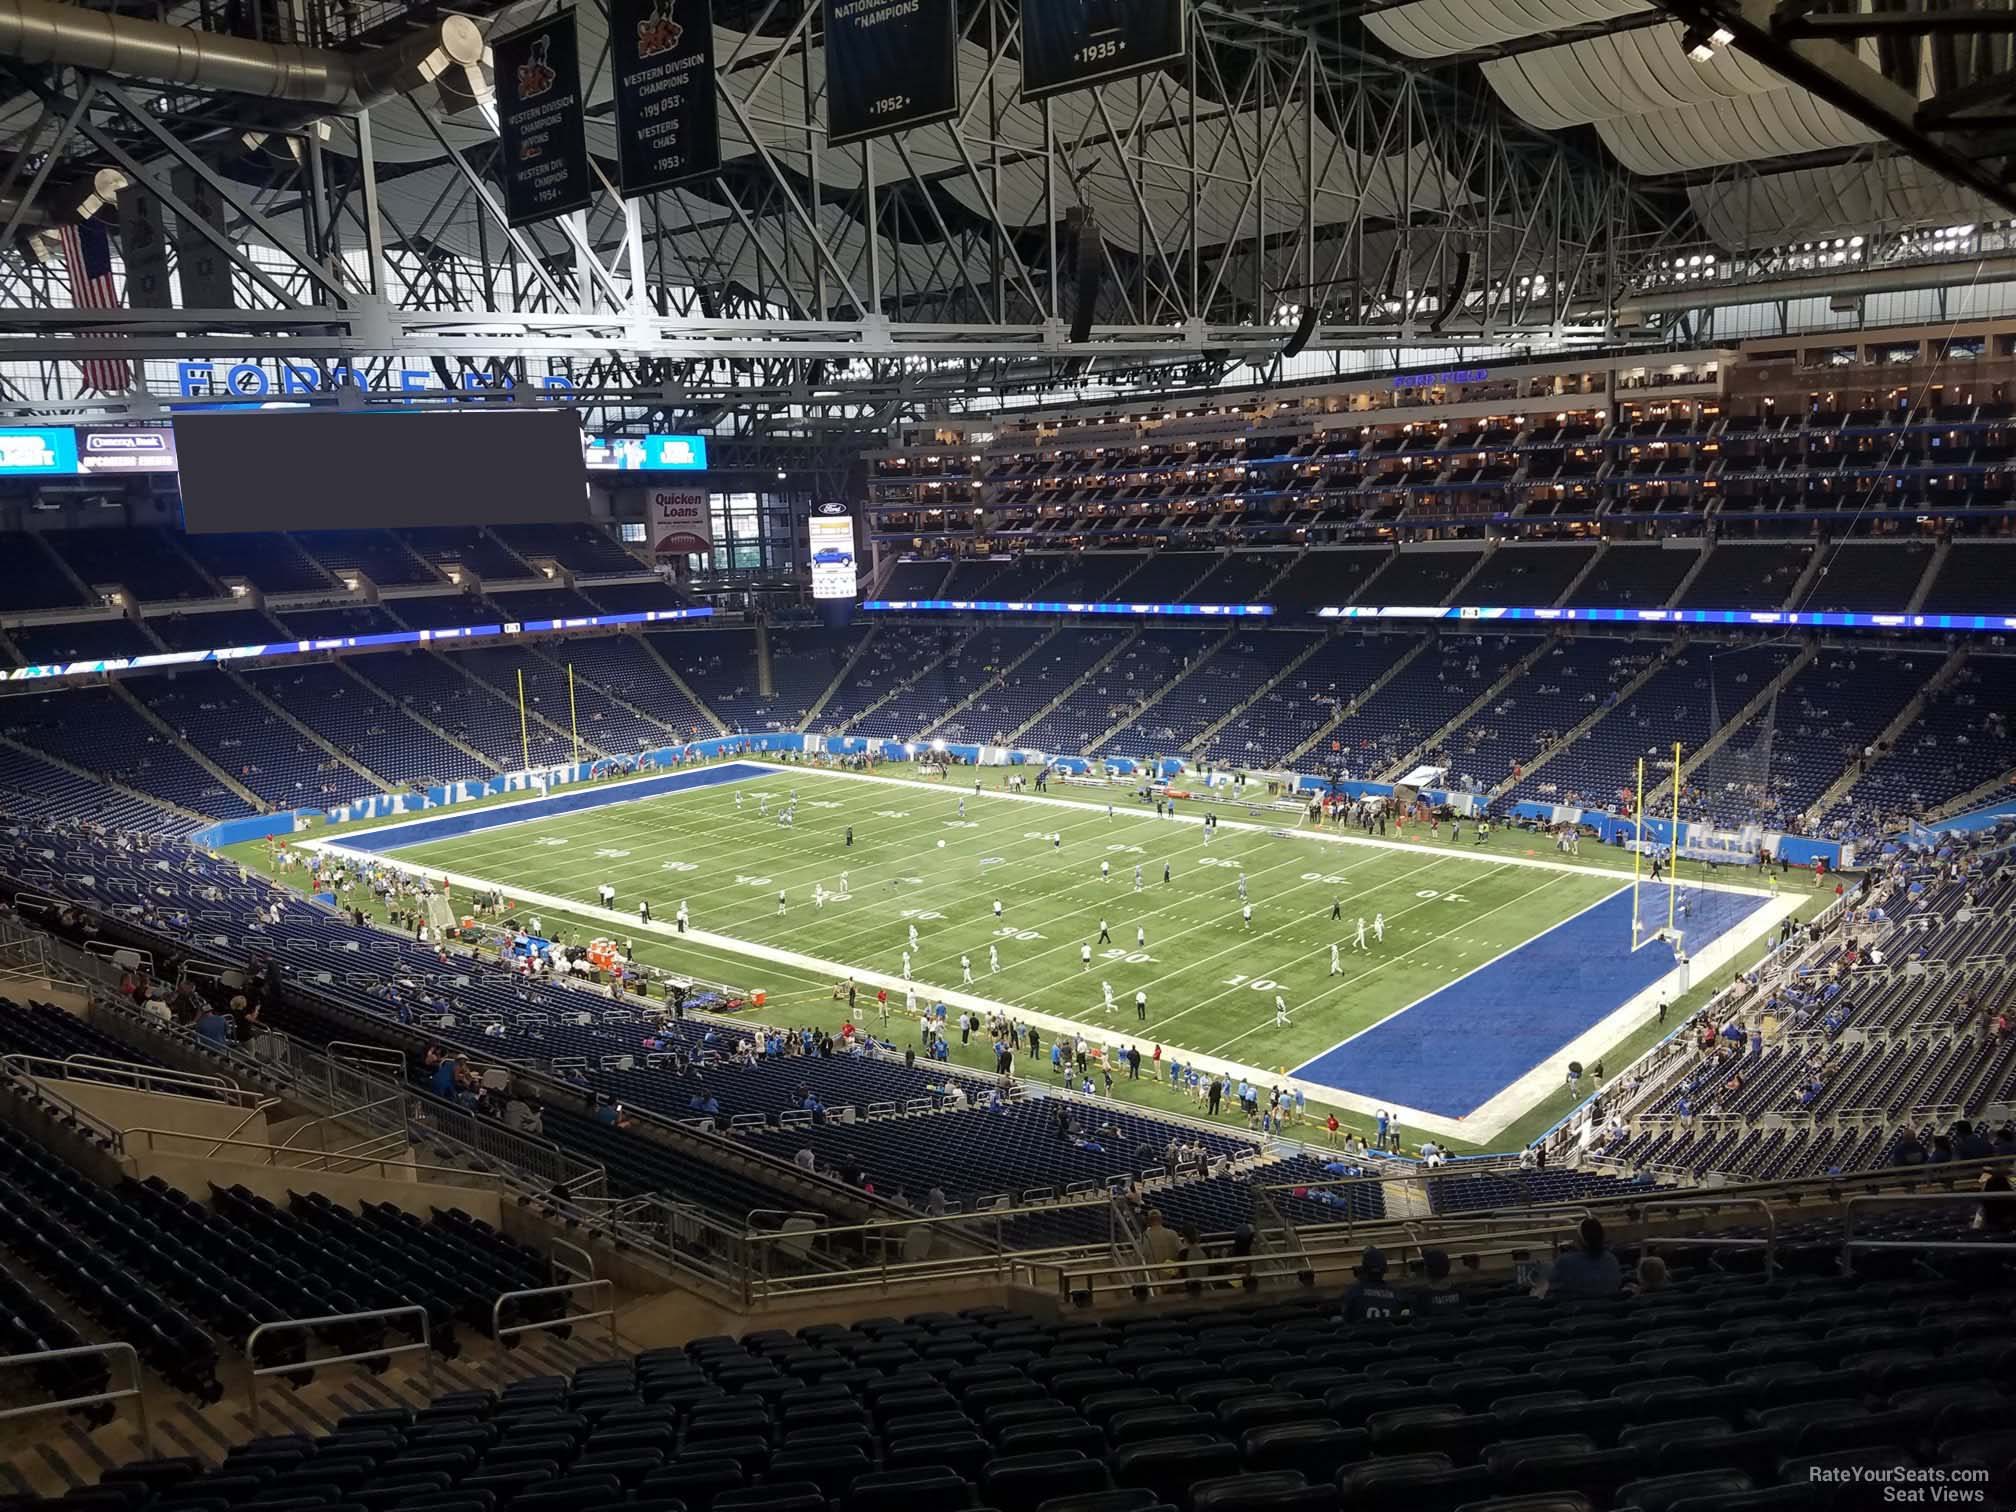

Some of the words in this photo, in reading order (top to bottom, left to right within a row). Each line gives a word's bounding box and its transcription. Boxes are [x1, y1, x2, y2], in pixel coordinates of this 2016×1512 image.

[1081, 41, 1116, 63] 1935
[664, 53, 705, 74] DIVISION
[639, 73, 690, 97] CHAMPIONS
[876, 95, 903, 115] 1952
[658, 155, 680, 170] 1953
[1393, 374, 1437, 387] FORD
[1440, 368, 1489, 385] FIELD
[655, 493, 702, 505] Quicken
[663, 506, 698, 518] Loans
[1221, 973, 1278, 992] 10
